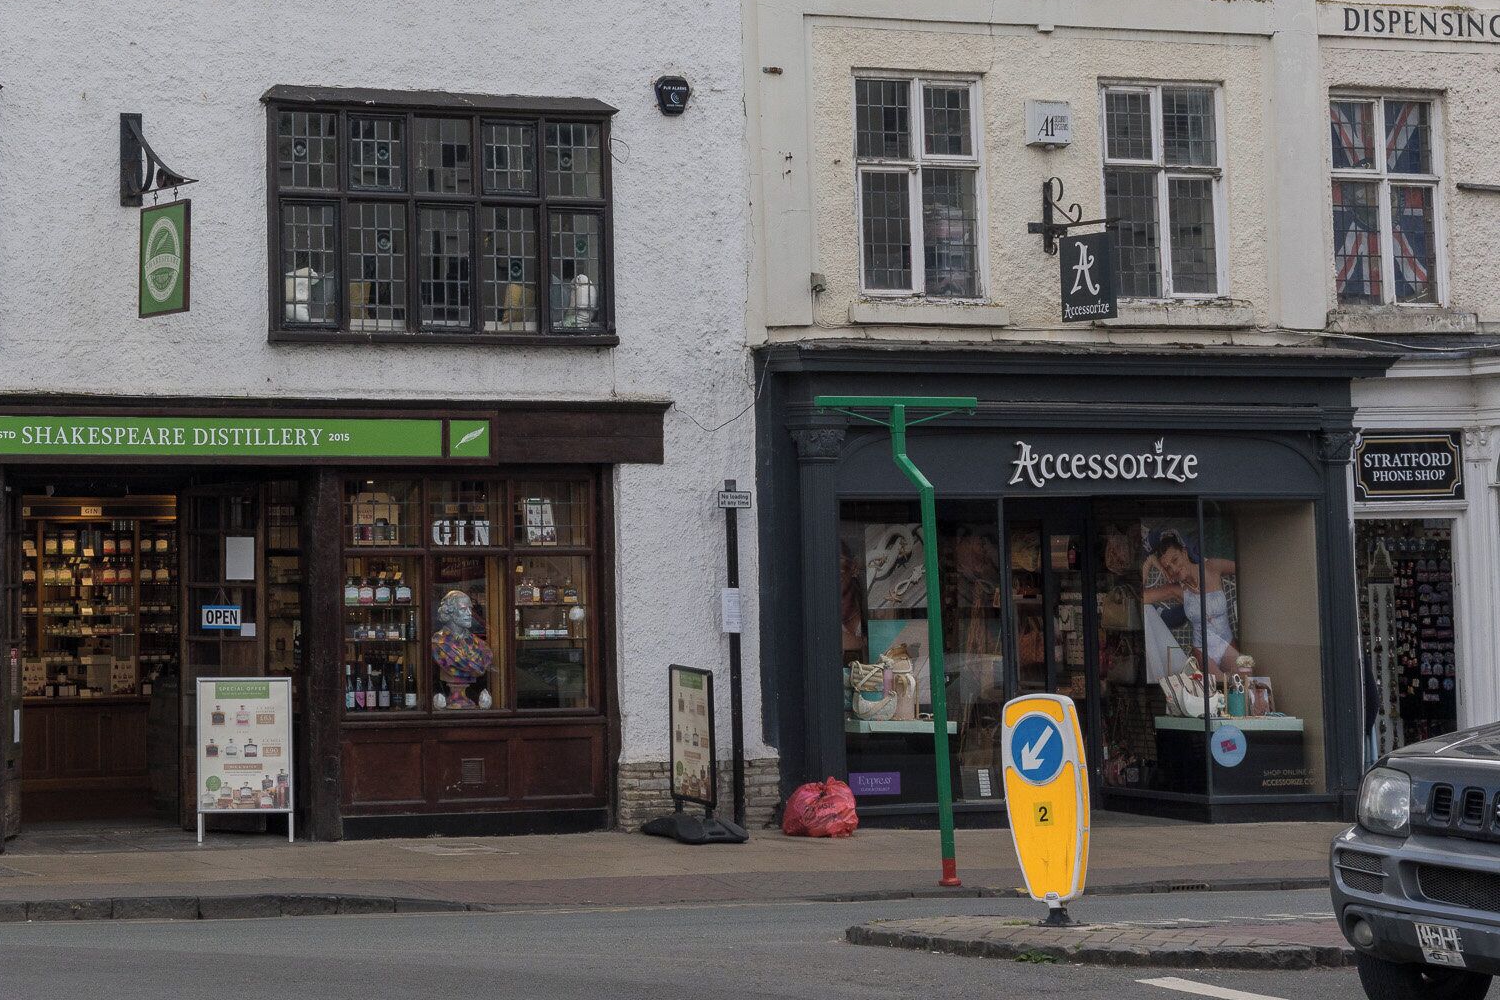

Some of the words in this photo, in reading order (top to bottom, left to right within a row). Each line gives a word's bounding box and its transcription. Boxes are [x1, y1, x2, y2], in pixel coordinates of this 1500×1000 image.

[1070, 241, 1100, 295] A
[1064, 300, 1110, 319] Accessorize
[21, 426, 186, 445] SHAKESPEARE
[193, 428, 323, 446] DISTILLERY
[328, 433, 350, 442] 2015
[1009, 437, 1198, 487] Accessorize
[1363, 452, 1452, 468] STRATFORD
[1373, 470, 1413, 482] PHONE
[1415, 469, 1446, 481] SHOP
[730, 493, 749, 501] loading
[432, 520, 490, 546] GIN
[206, 609, 237, 625] OPEN
[858, 775, 893, 786] Express
[1263, 769, 1281, 777] SHOP
[1282, 768, 1307, 776] ONLINE
[1038, 806, 1049, 822] 2
